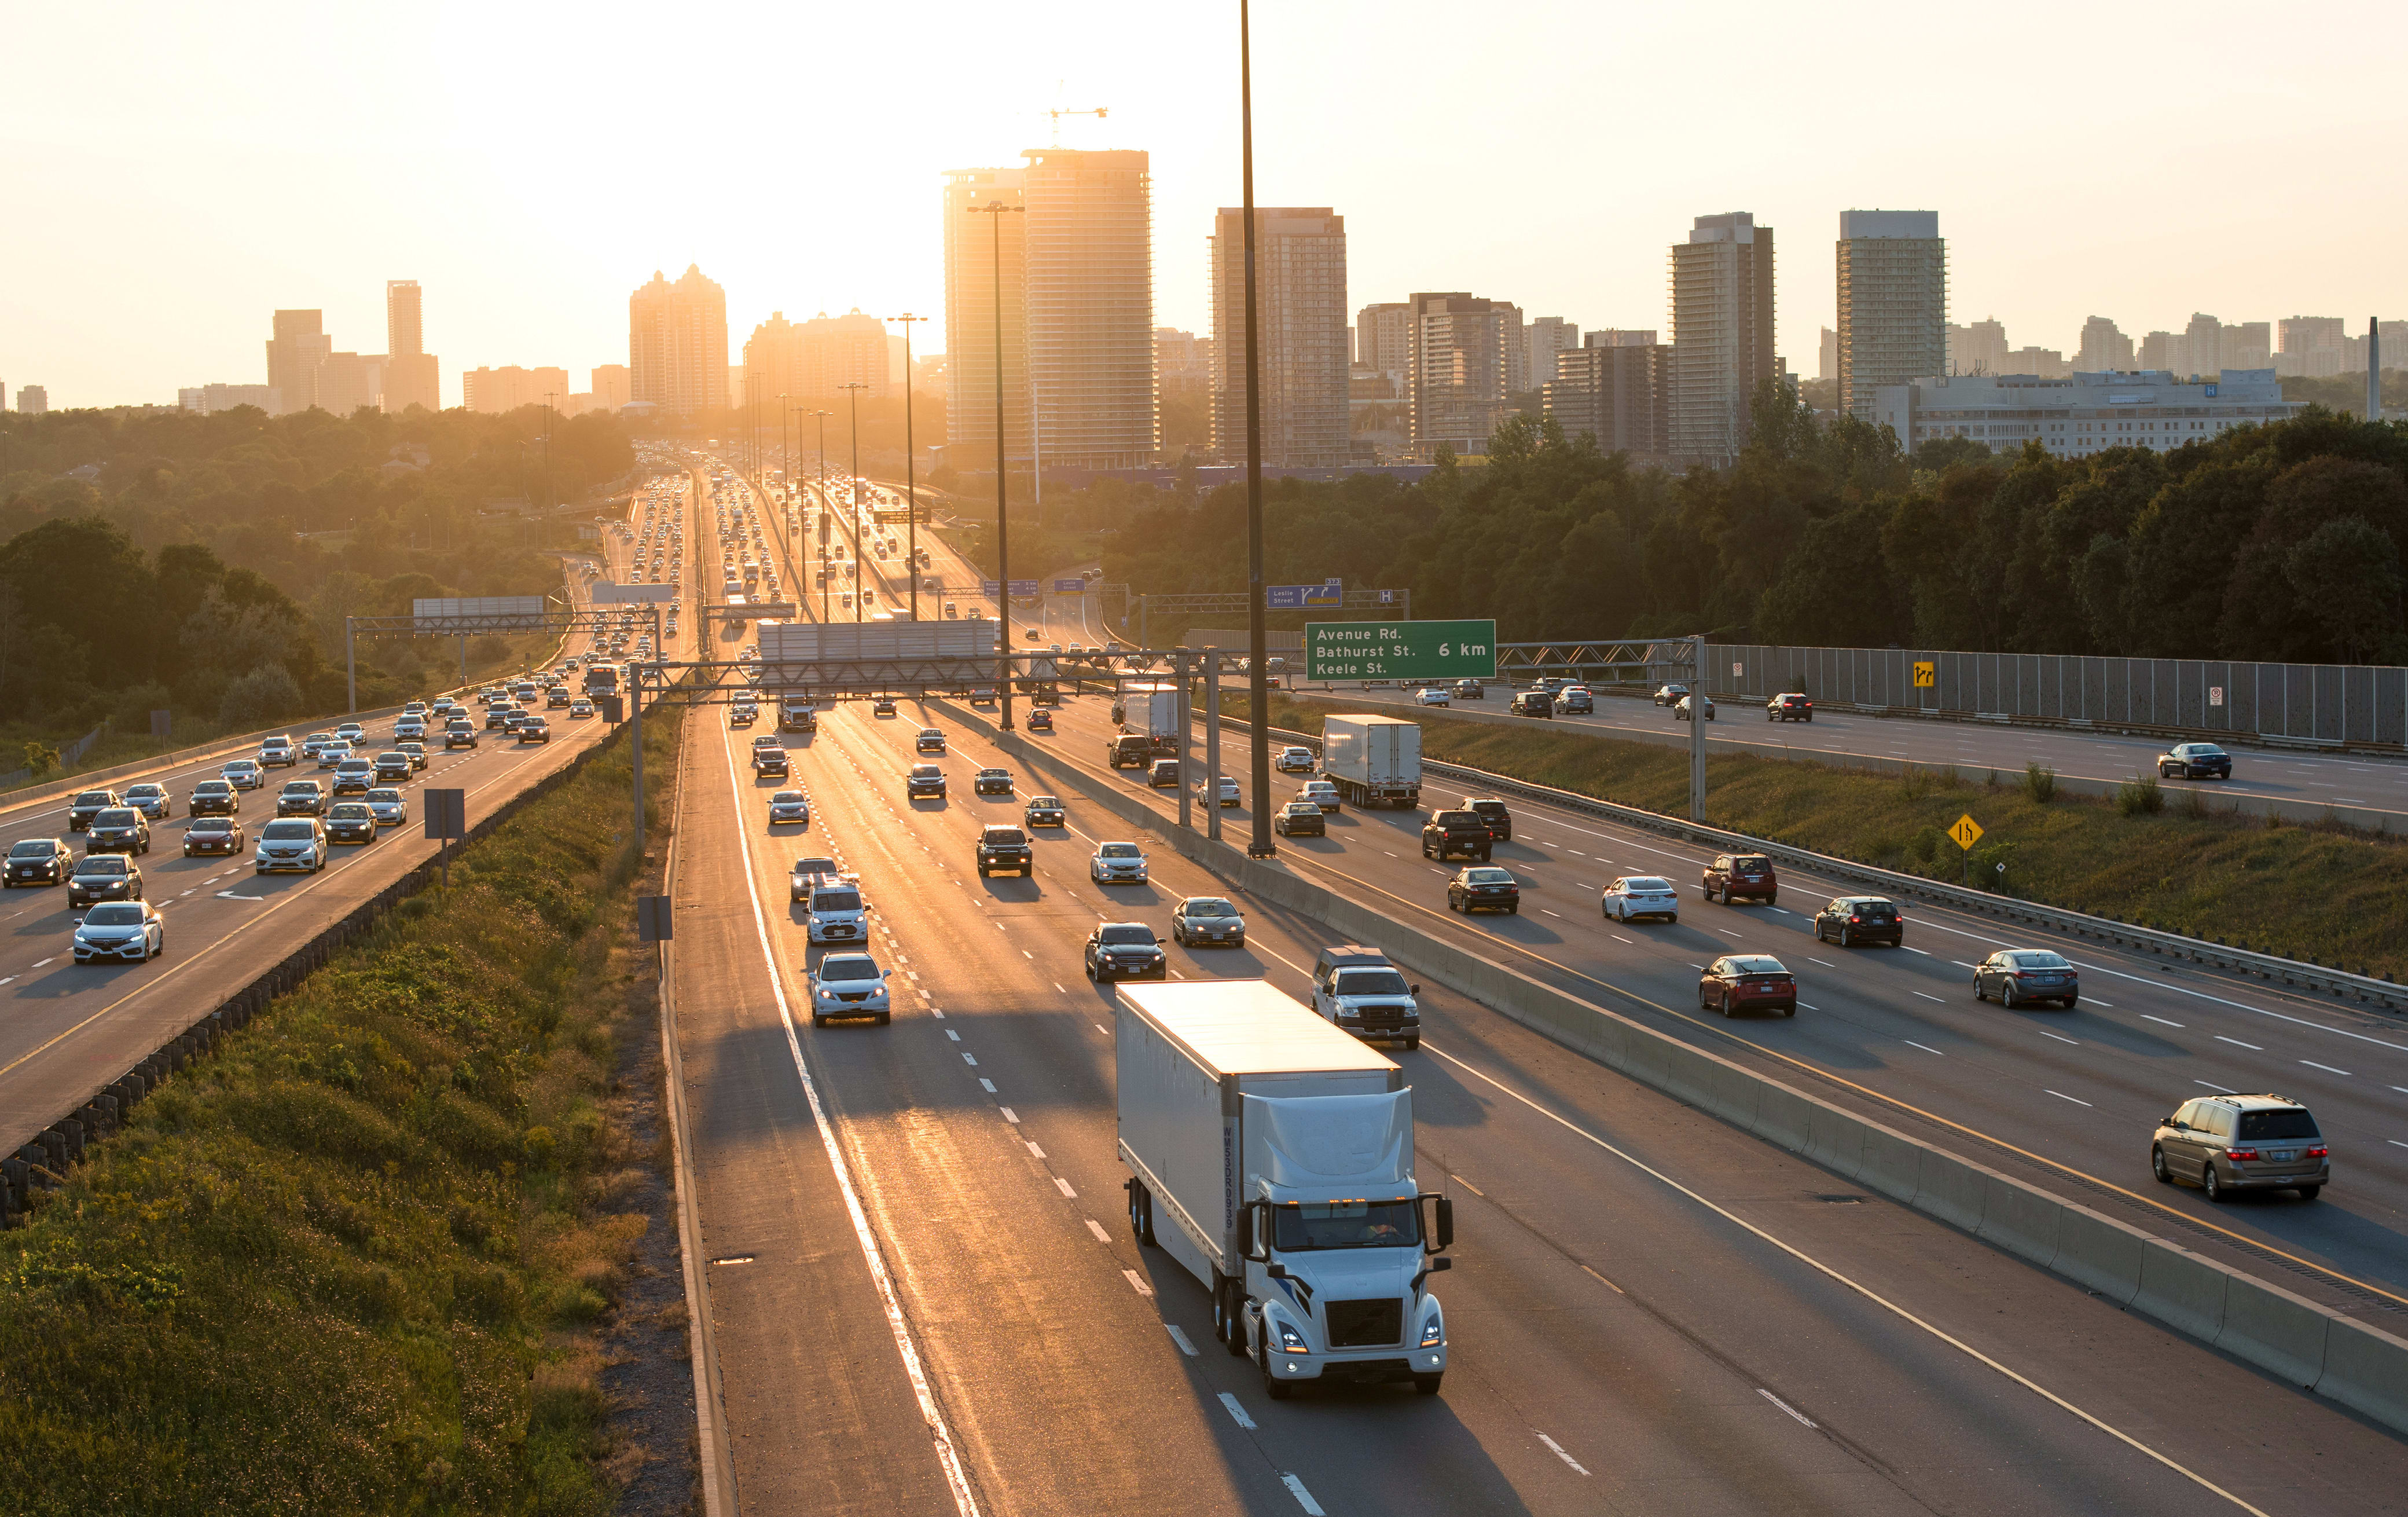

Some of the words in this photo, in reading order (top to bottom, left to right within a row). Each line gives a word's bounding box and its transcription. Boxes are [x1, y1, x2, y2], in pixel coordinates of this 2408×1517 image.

[2208, 386, 2214, 395] H
[1382, 591, 1390, 602] H
[1317, 629, 1371, 640] Avenue
[1379, 628, 1402, 639] Rd.
[1316, 646, 1384, 658] Bathurst
[1393, 645, 1416, 657] St.
[1439, 643, 1450, 657] 6
[1460, 643, 1486, 656] km
[1317, 663, 1357, 675] Keele
[1367, 662, 1387, 674] St.
[1224, 1127, 1232, 1229] WM53DR0939
